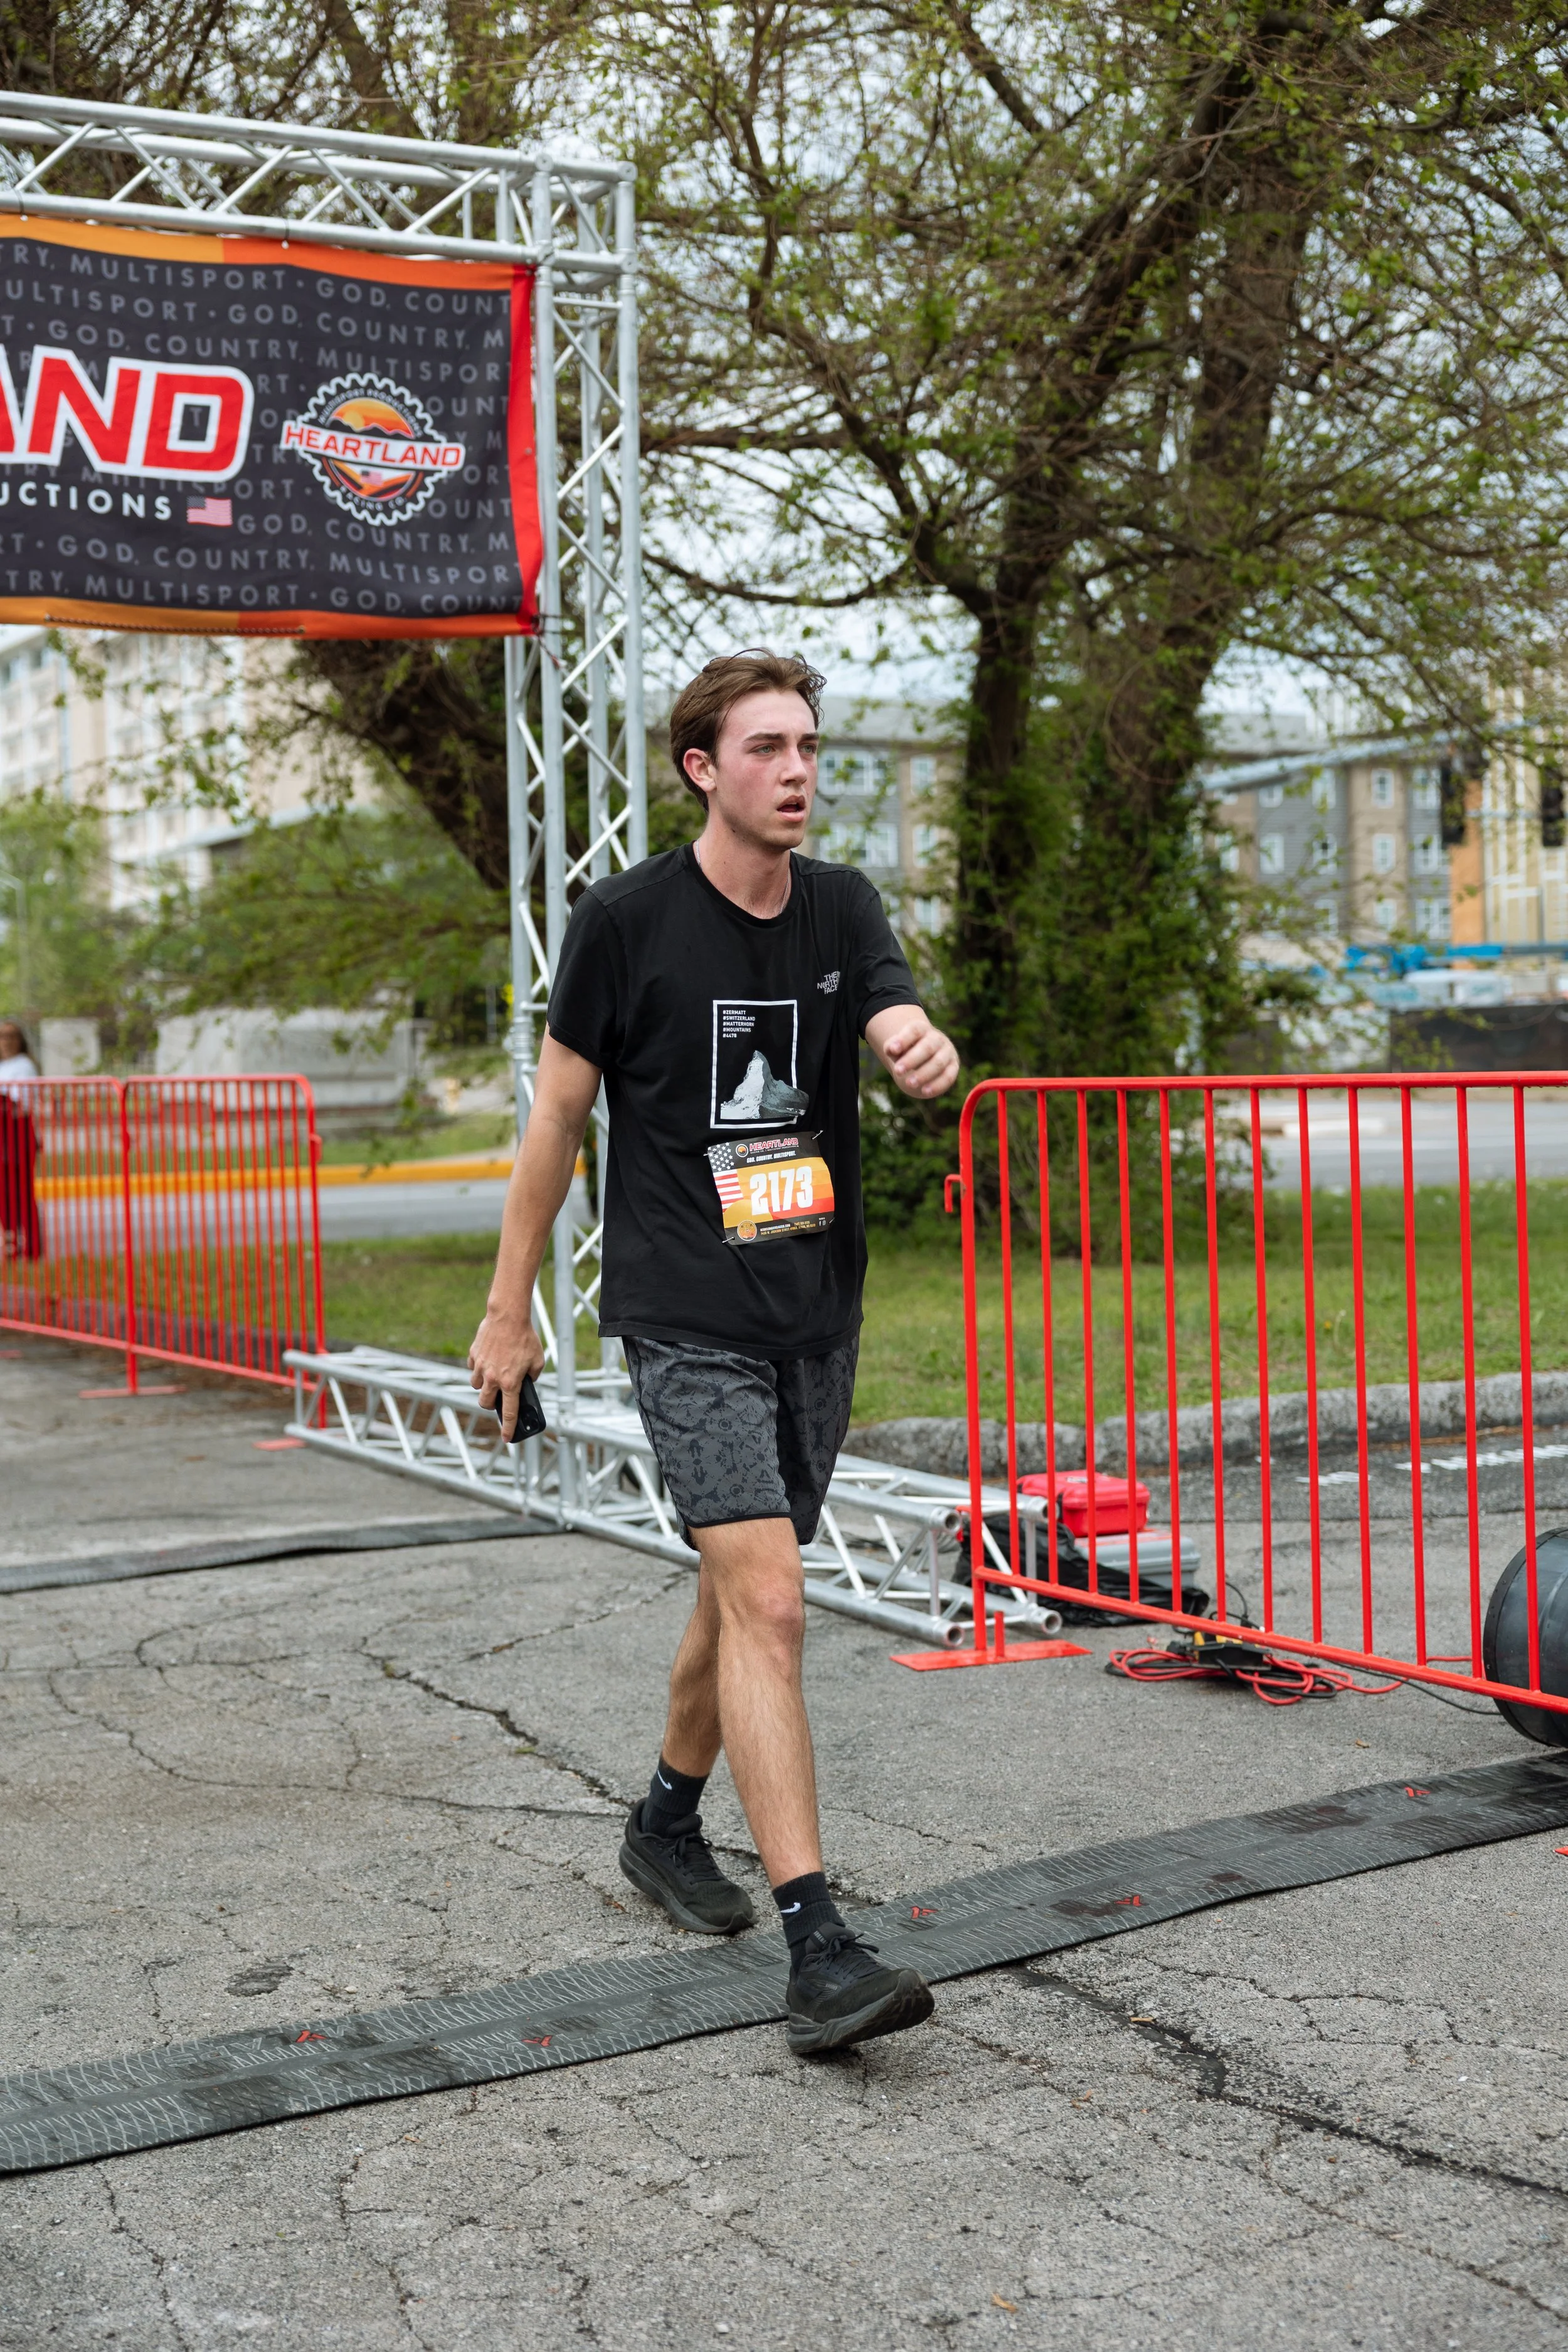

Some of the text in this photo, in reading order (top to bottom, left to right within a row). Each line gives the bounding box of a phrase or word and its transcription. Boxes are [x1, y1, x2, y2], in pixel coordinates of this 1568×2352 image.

[70, 253, 286, 290] MULTISPORT
[316, 347, 510, 383] MULTISPOR
[0, 344, 254, 482] ND
[284, 425, 462, 467] HEARTLAND
[329, 553, 521, 584] MULTISPOR
[84, 573, 299, 607] MULTISPORT
[817, 978, 838, 989] NORTH
[824, 971, 837, 982] THE
[824, 984, 838, 994] FACE
[749, 1137, 799, 1152] HEARTLAND
[750, 1165, 813, 1216] 2173
